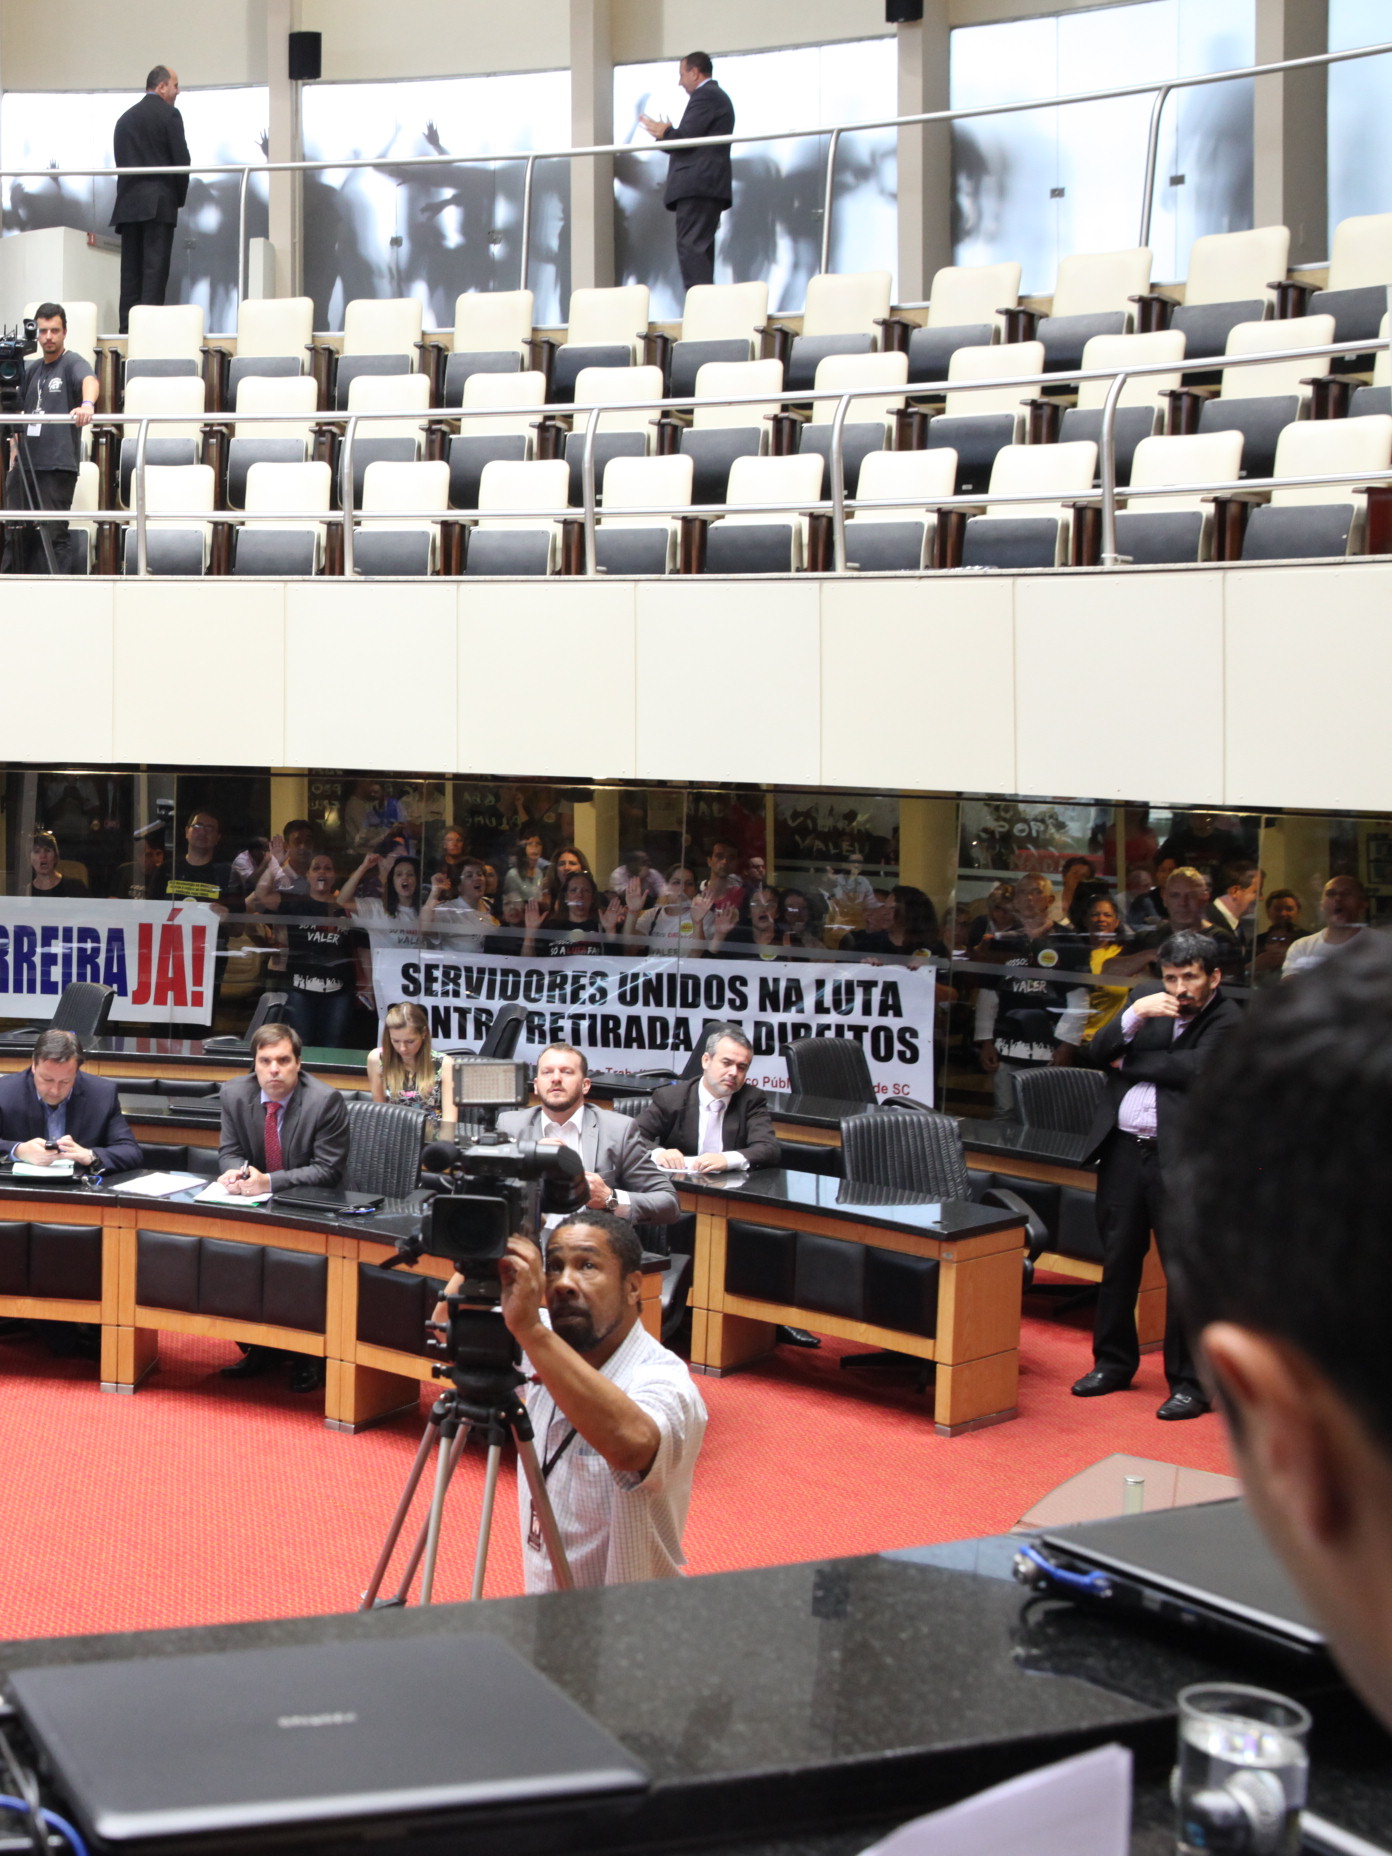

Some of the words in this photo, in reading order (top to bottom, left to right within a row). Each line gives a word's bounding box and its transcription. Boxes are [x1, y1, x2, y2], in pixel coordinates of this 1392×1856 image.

[307, 931, 340, 946] VALER
[131, 907, 207, 1007] JÁ!
[401, 962, 608, 1006] SERVIDORES
[617, 972, 749, 1012] UNIDOS
[759, 977, 805, 1014] NA
[814, 979, 903, 1018] LUTA
[1012, 979, 1048, 993] VALER
[526, 1010, 694, 1052] RETIRADA
[892, 1083, 911, 1096] SC
